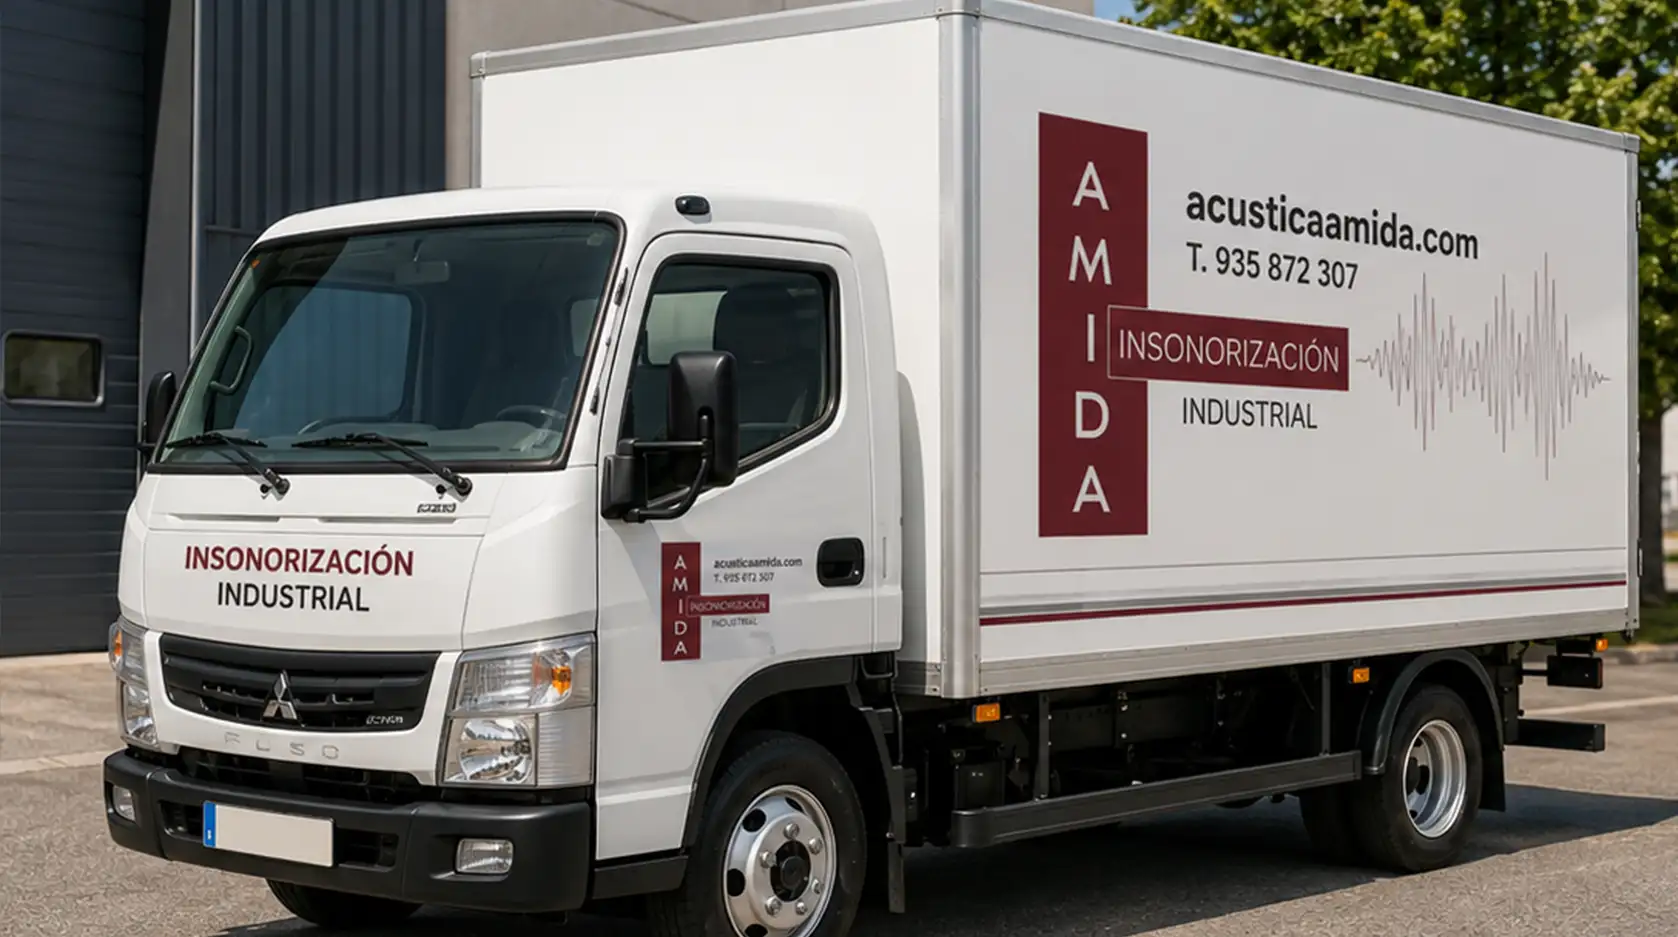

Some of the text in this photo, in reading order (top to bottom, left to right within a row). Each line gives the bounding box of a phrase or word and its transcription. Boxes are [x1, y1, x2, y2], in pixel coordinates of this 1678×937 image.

[1186, 190, 1479, 260] acusticaamida.com
[1186, 241, 1358, 290] T. 935 872 307
[1068, 161, 1112, 513] AMIDA
[1119, 328, 1339, 373] INSONORIZACIÓN
[1182, 397, 1318, 429] INDUSTRIAL
[185, 544, 414, 576] INSONORIZACIÓN
[714, 556, 803, 569] acusticaamida.com
[217, 581, 370, 612] INDUSTRIAL
[672, 554, 689, 655] AMIDA
